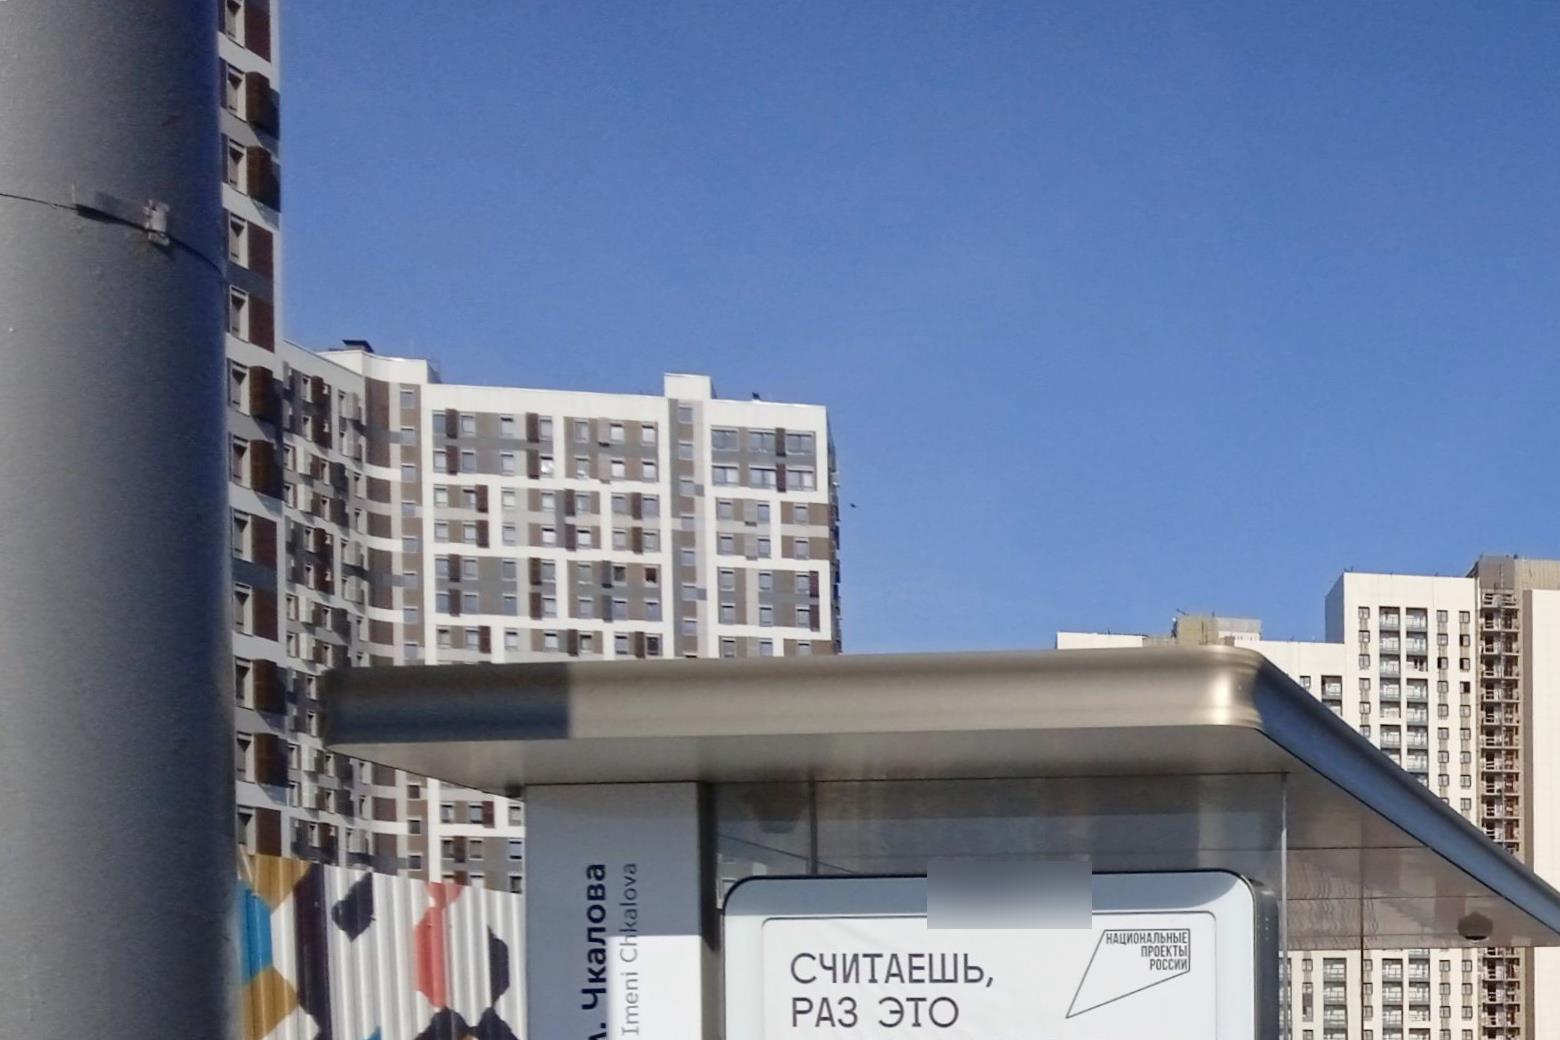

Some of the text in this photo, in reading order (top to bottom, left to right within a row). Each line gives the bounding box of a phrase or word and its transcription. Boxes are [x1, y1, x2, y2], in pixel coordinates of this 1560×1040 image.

[620, 863, 638, 963] Chkalova
[581, 864, 607, 1010] Чкалова
[1106, 932, 1187, 945] НАЦИОНАЛЬНЫЕ
[1141, 945, 1187, 957] ПРОЕКТЫ
[791, 953, 993, 987] СЧИТАЕШЬ,
[1150, 959, 1187, 970] РОССИИ
[621, 971, 639, 1036] Imeni
[792, 997, 959, 1028] РАЗ ЭТО
